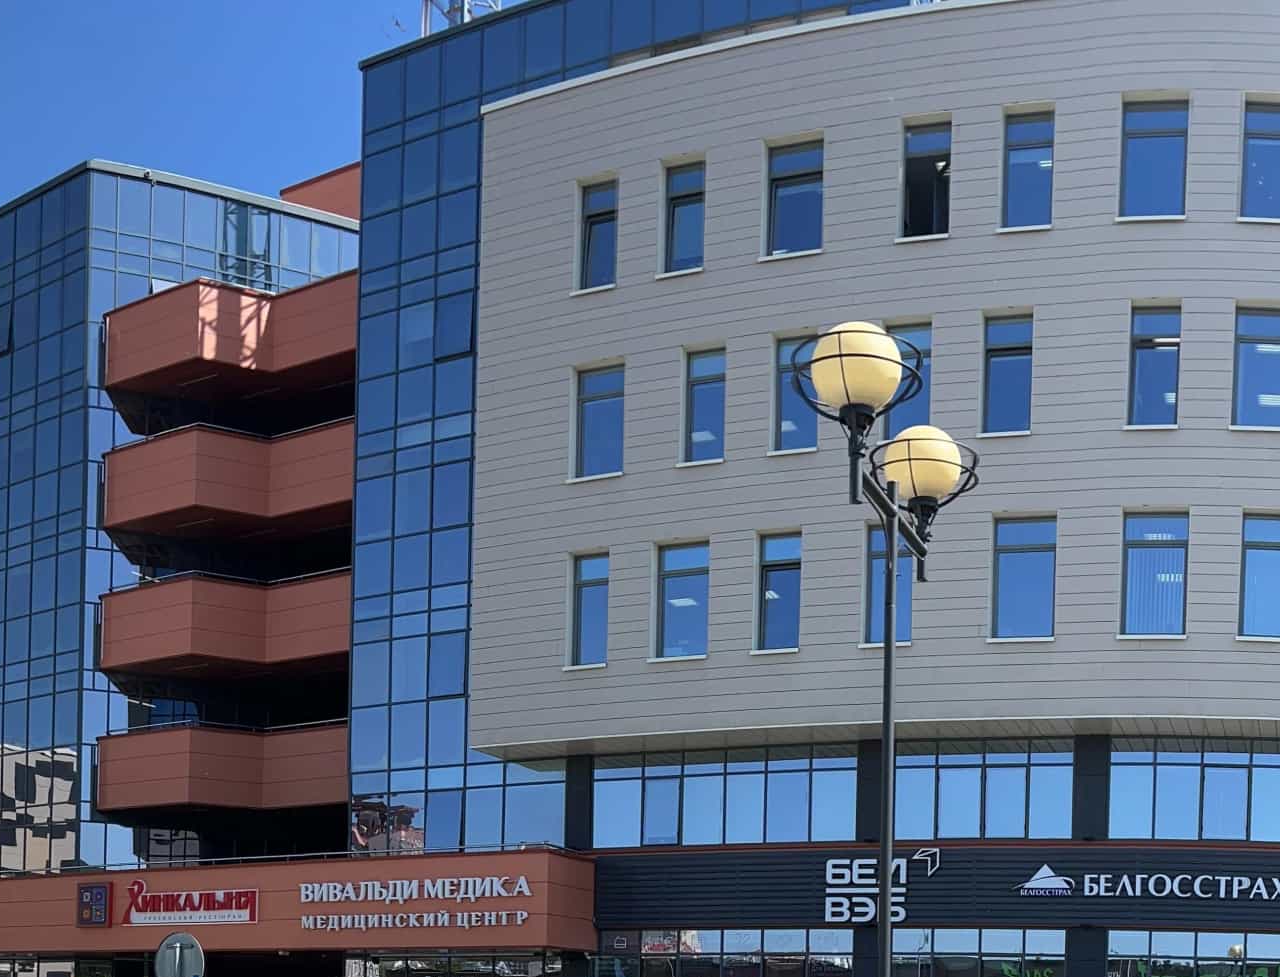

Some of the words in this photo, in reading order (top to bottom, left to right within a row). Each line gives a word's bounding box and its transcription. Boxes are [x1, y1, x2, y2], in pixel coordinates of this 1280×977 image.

[826, 858, 907, 884] БЕЛ
[299, 879, 419, 904] ВИВАЛЬДИ
[424, 876, 532, 903] МЕДИКА
[301, 910, 450, 931] МЕДИЦИНСКИЙ
[456, 911, 528, 930] ЦЕНТР
[825, 896, 907, 922] ВЭБ
